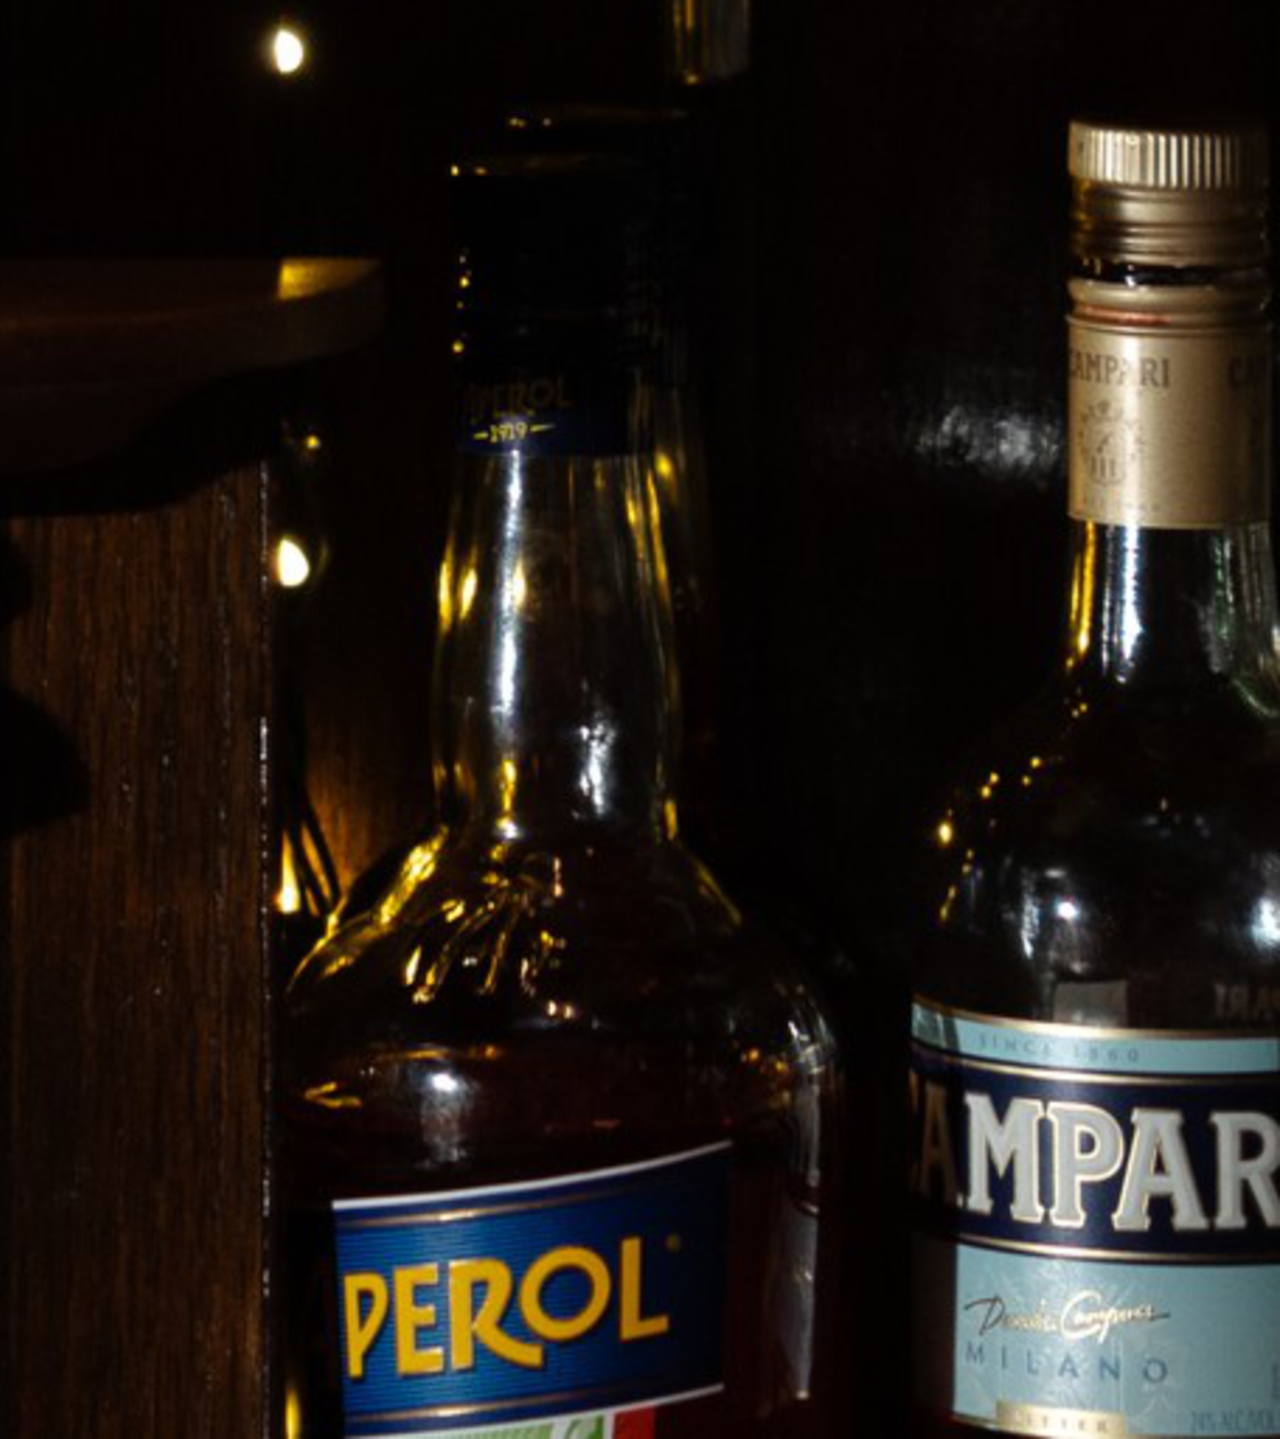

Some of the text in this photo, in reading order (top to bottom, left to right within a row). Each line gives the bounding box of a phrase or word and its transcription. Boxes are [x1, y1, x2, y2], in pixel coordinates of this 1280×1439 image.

[978, 1034, 1140, 1064] SINCE 1860
[343, 1237, 670, 1379] PEROL
[964, 1341, 1169, 1384] MILANO
